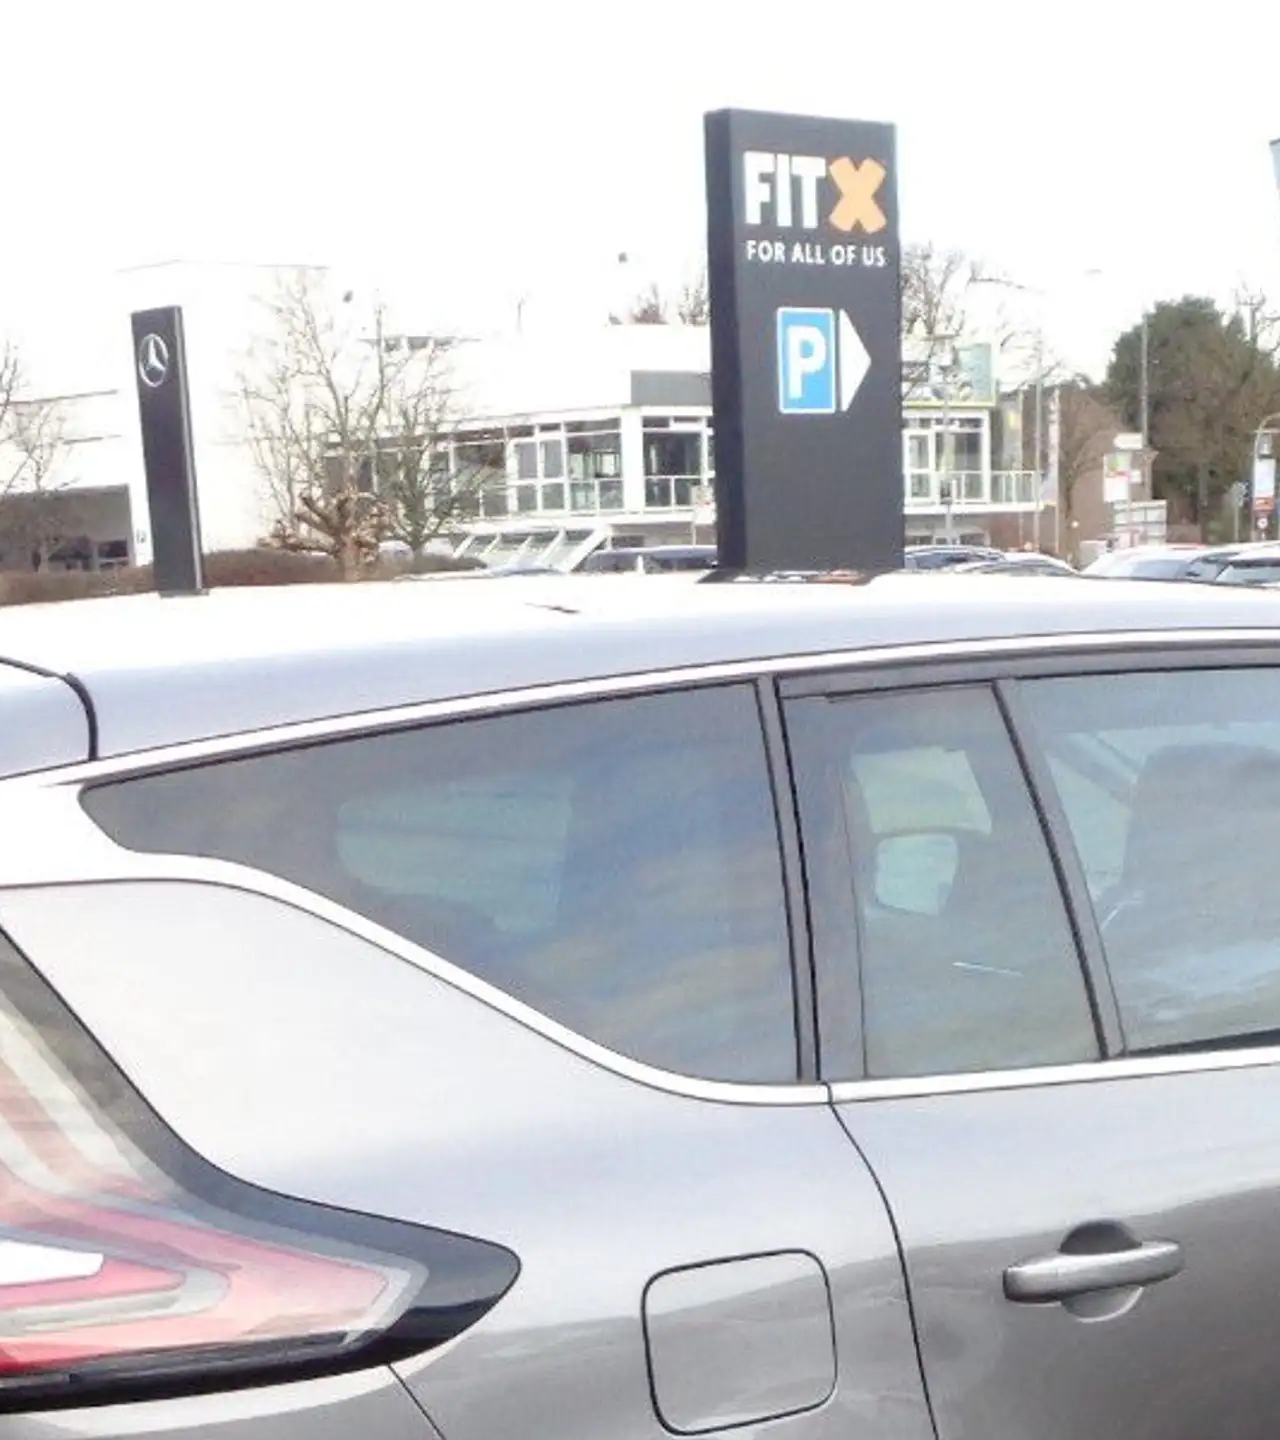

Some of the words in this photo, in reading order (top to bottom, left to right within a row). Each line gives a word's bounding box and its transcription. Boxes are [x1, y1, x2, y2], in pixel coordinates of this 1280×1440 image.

[743, 150, 887, 234] FITX
[746, 240, 786, 264] FOR
[791, 241, 826, 265] ALL
[831, 244, 857, 266] OF
[862, 246, 887, 268] US
[787, 325, 827, 399] P
